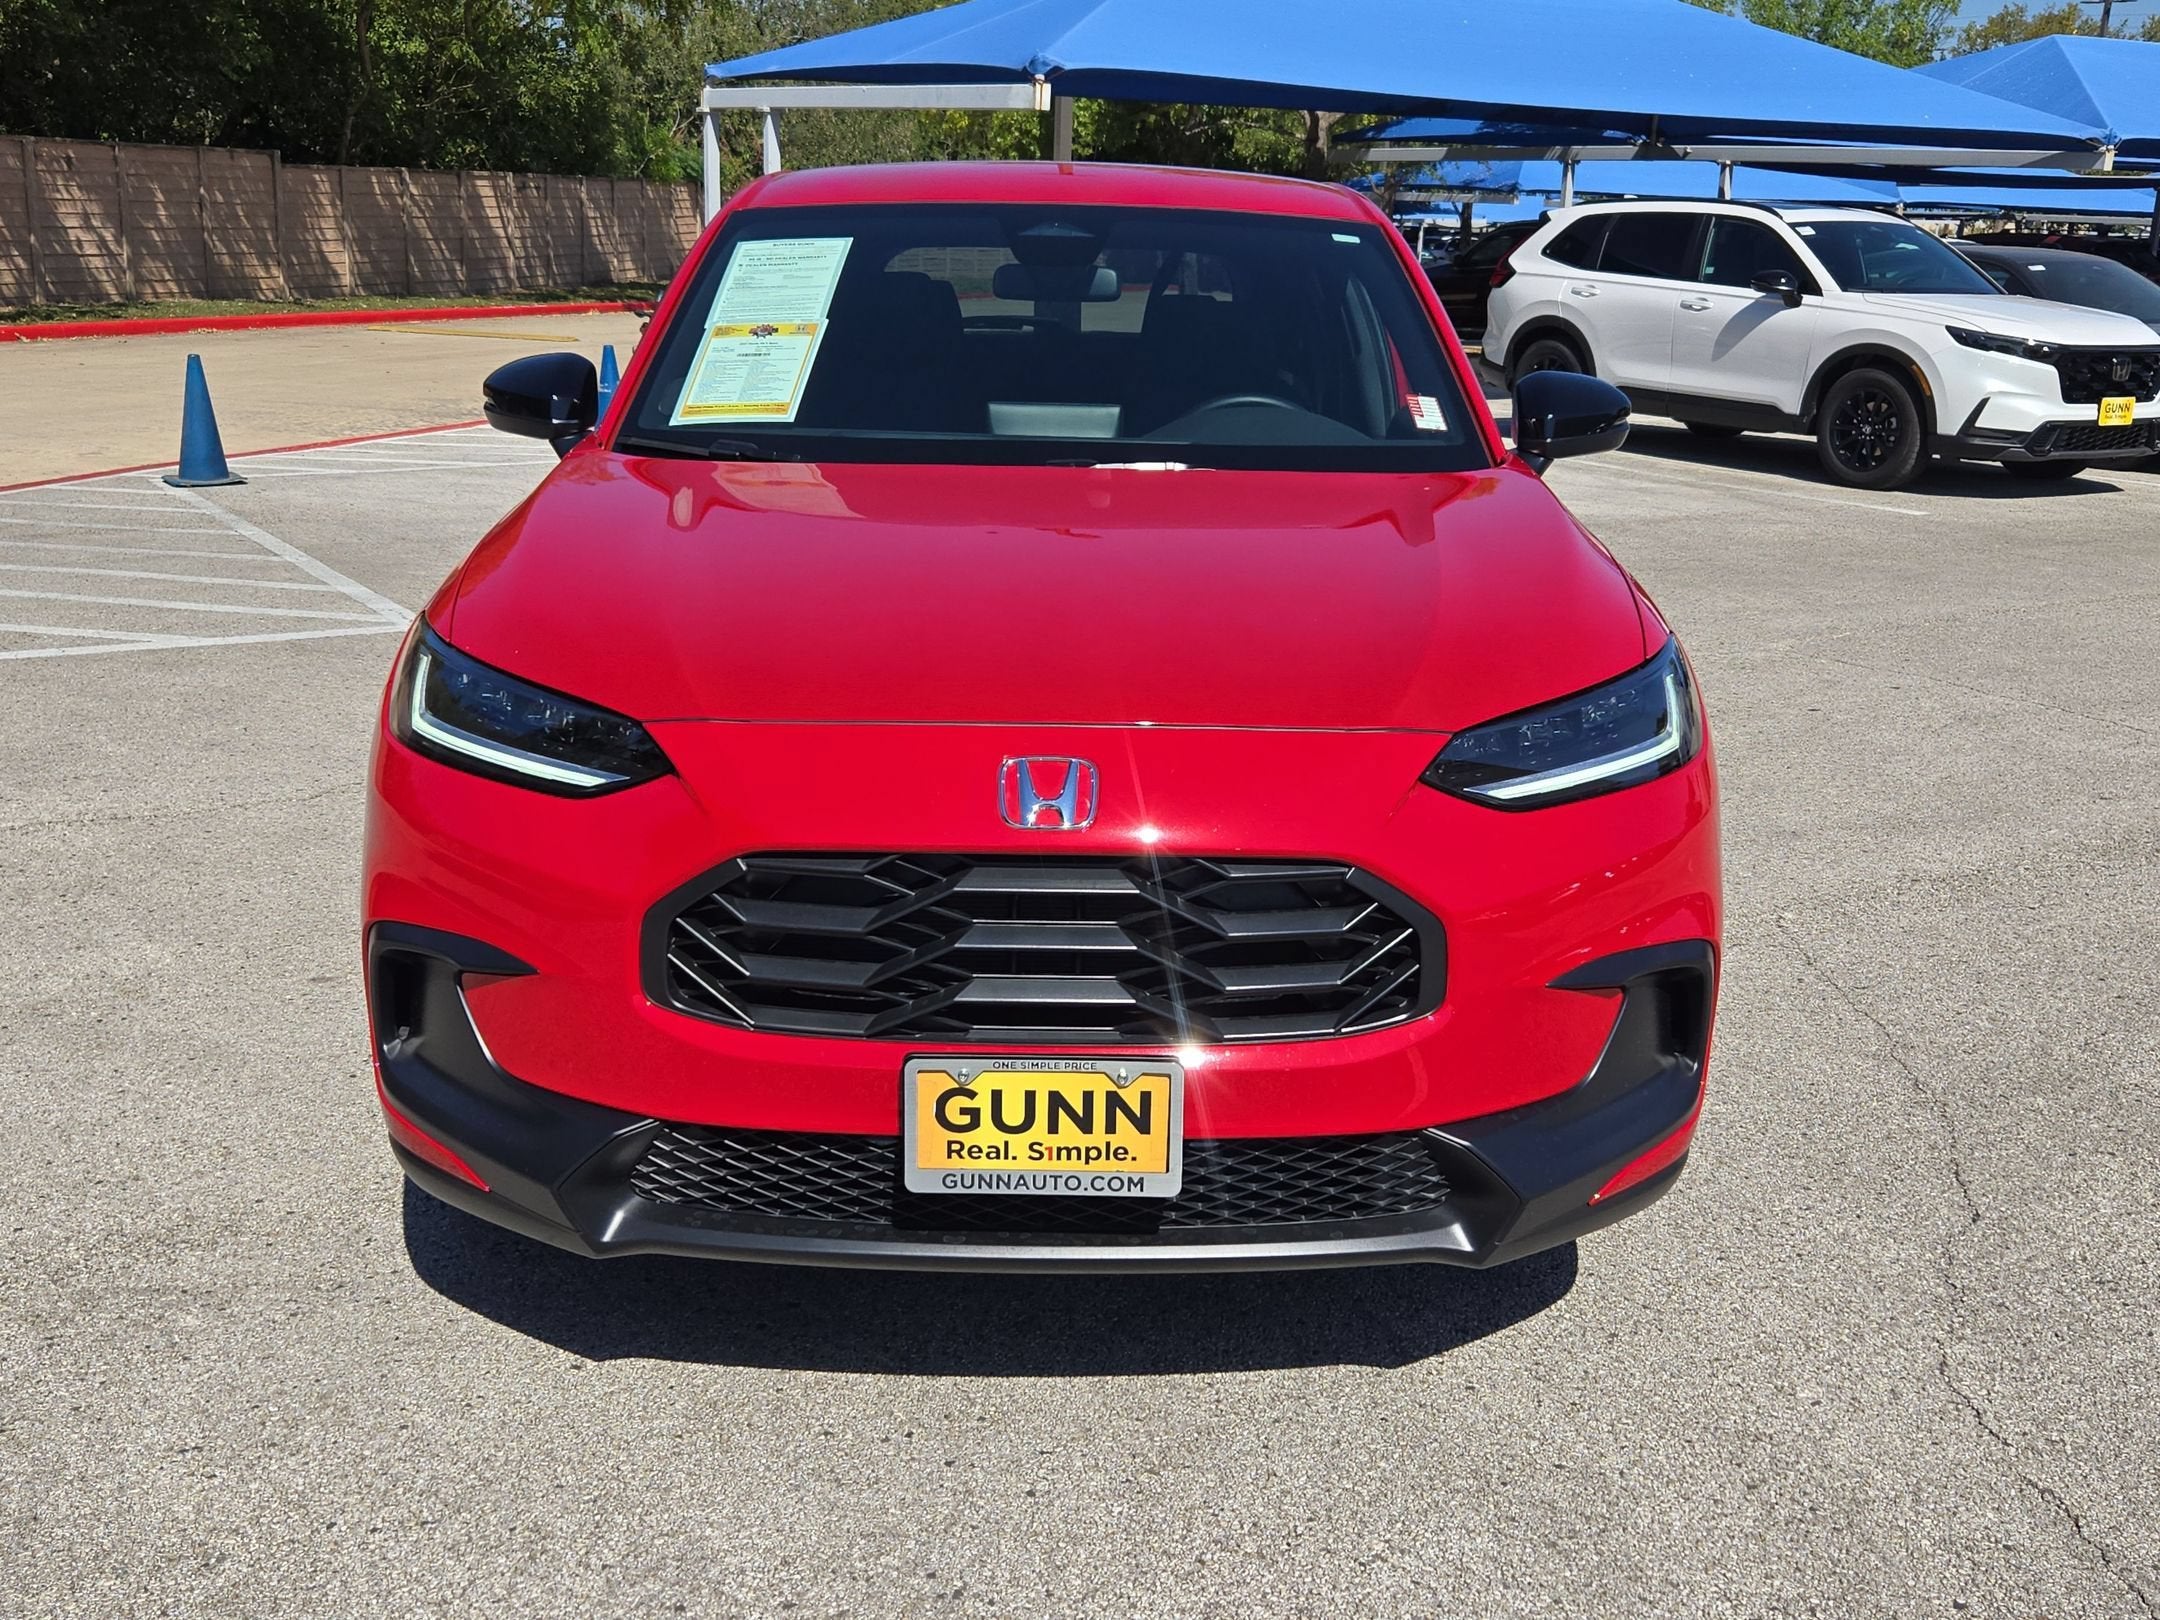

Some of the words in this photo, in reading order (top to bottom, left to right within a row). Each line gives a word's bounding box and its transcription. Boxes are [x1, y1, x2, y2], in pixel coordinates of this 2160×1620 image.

[2104, 403, 2131, 414] GUNN
[992, 1061, 1017, 1070] ONE
[1020, 1061, 1061, 1070] SIMPLE
[1064, 1062, 1097, 1071] PRICE
[935, 1087, 1152, 1136] GUNN
[946, 1140, 1018, 1161] Real.
[942, 1173, 1145, 1193] GUNNAUTO.COM
